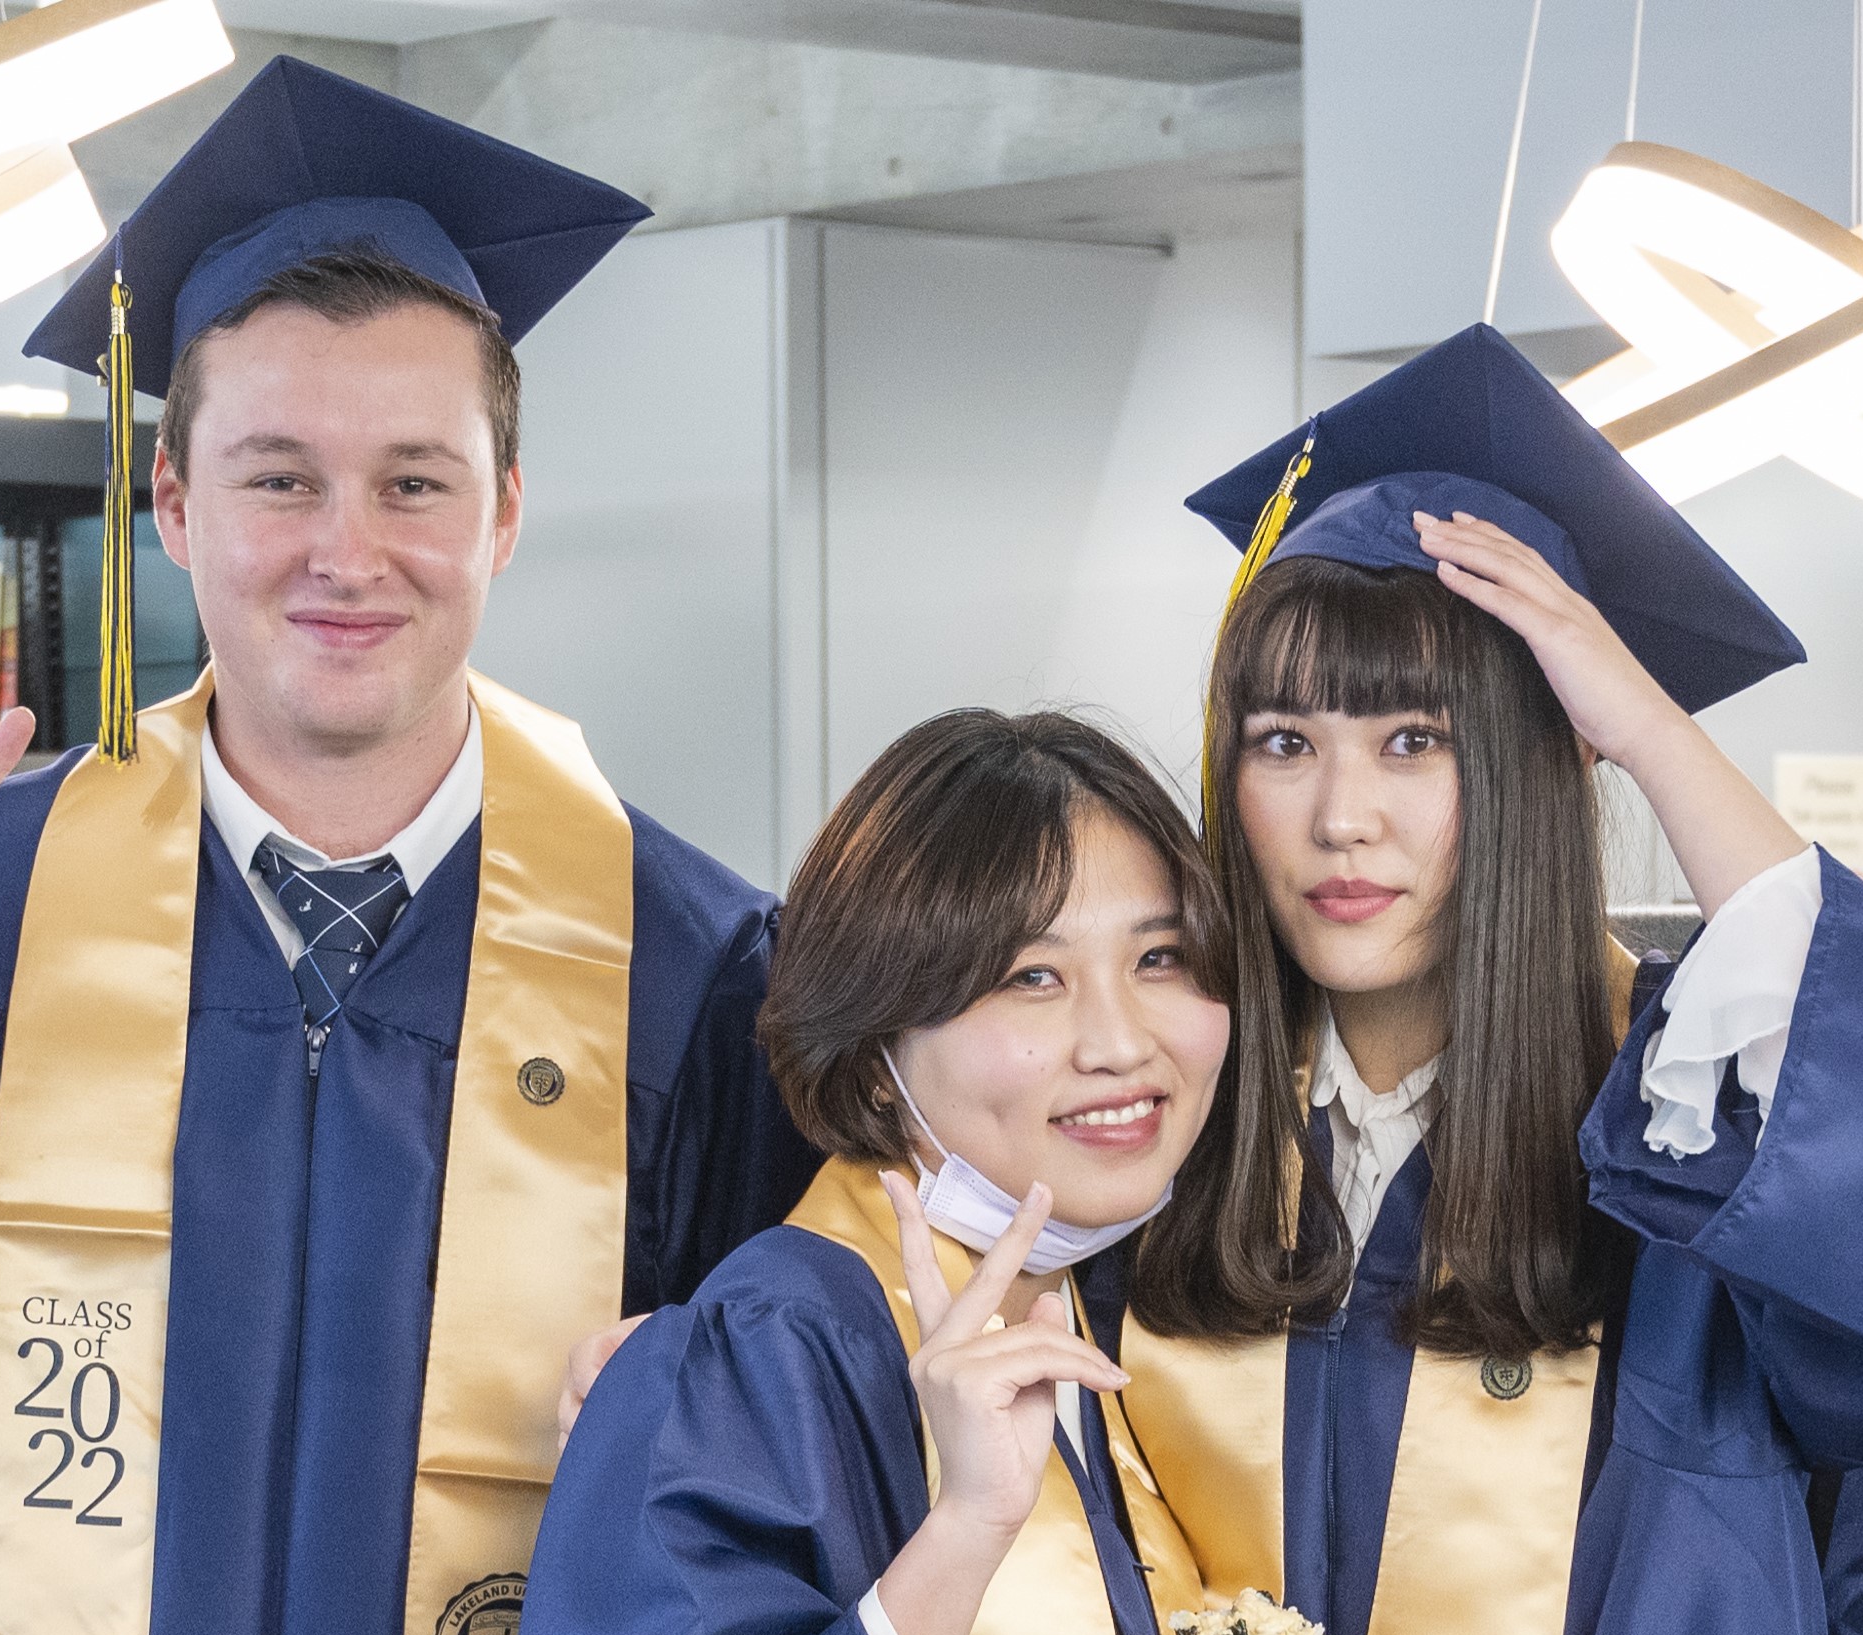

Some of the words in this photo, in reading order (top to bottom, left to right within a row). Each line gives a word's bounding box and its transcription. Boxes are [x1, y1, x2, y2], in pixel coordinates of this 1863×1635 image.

[22, 1296, 132, 1330] CLASS
[73, 1330, 111, 1359] of
[14, 1336, 121, 1443] 20
[23, 1428, 126, 1527] 22
[449, 1584, 510, 1628] LAKELAND
